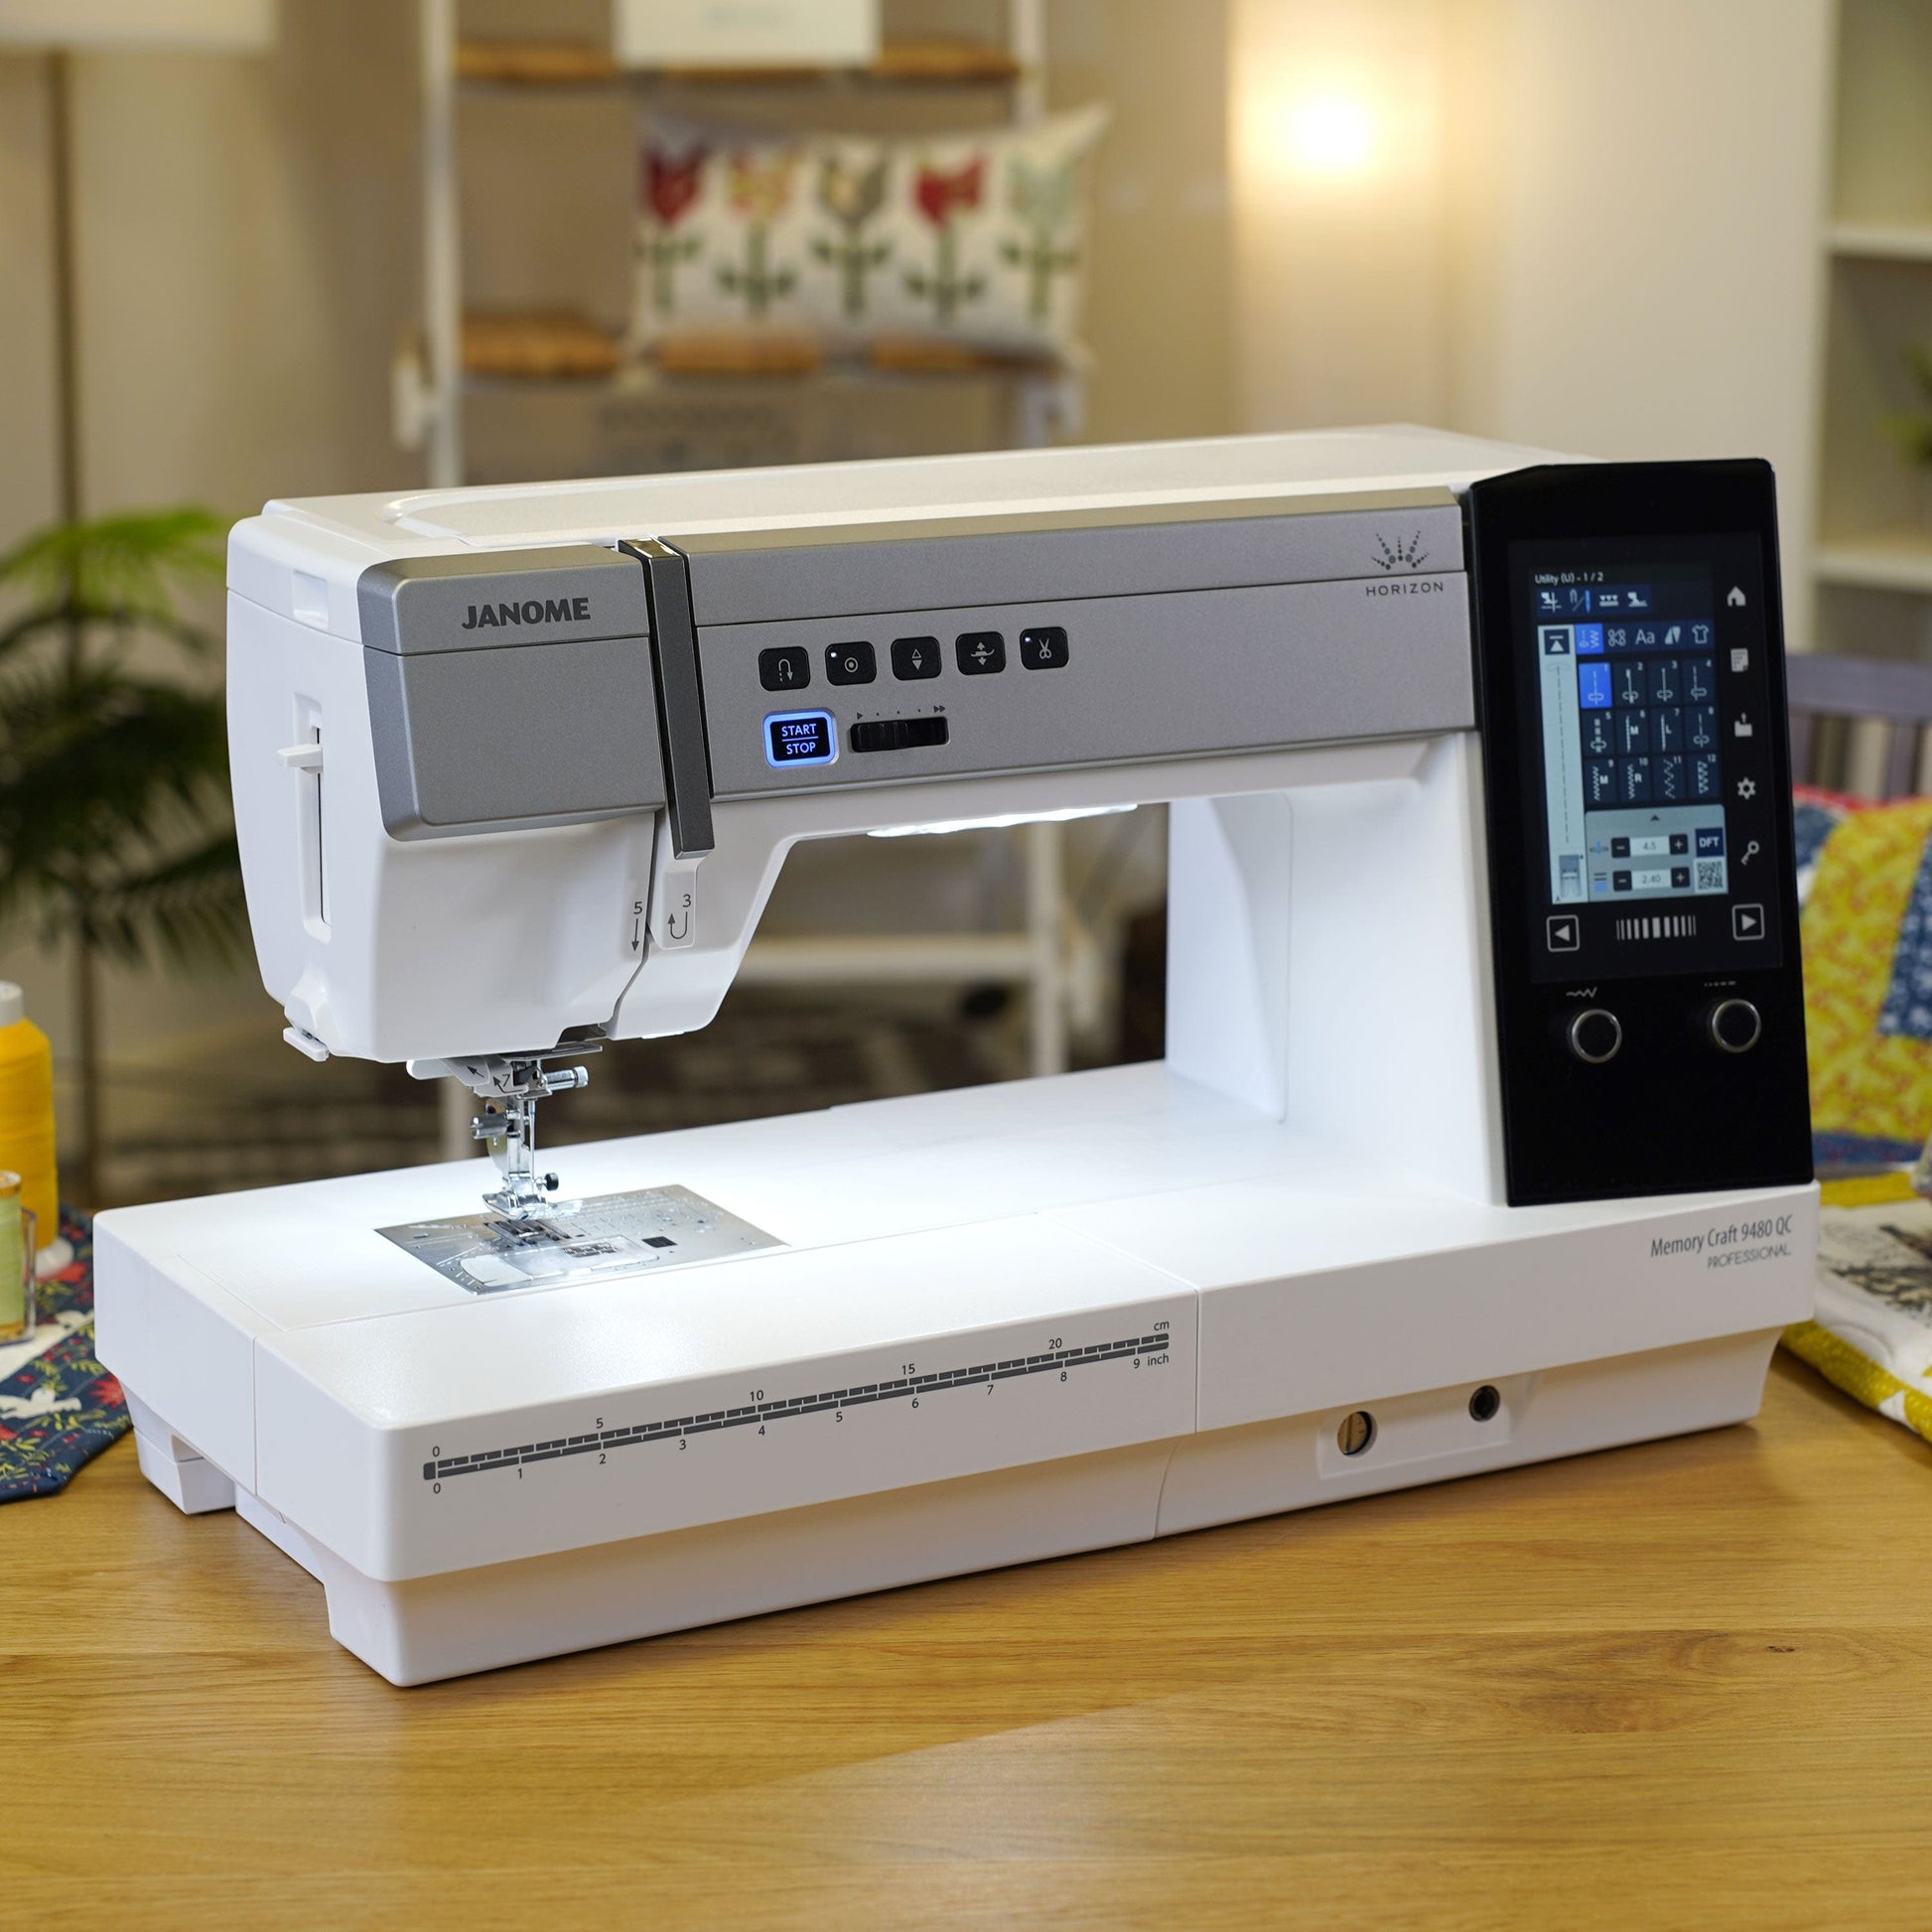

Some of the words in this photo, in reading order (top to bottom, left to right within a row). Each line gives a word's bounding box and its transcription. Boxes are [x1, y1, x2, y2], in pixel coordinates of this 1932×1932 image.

[1534, 573, 1559, 586] Utility
[1597, 571, 1604, 583] 2
[1365, 582, 1444, 597] HORIZON
[462, 597, 591, 630] JANOME
[1635, 628, 1656, 645] Aa
[1637, 661, 1644, 671] 2
[780, 723, 817, 738] START
[785, 740, 817, 756] STOP
[1708, 754, 1717, 762] 12
[1699, 836, 1720, 848] DFT
[1641, 874, 1661, 885] 2.40
[633, 901, 643, 915] 5
[682, 895, 692, 908] 3
[501, 1073, 511, 1088] 7
[1650, 1236, 1705, 1258] Memory
[1708, 1224, 1737, 1247] Craft
[1741, 1218, 1773, 1241] 9480
[1775, 1214, 1793, 1236] QC
[1707, 1243, 1792, 1269] PROFESSIONAL
[432, 1446, 441, 1458] 0
[596, 1417, 604, 1429] 5
[750, 1390, 764, 1402] 10
[901, 1363, 915, 1375] 15
[1048, 1337, 1062, 1350] 20
[1153, 1320, 1170, 1331] cm
[433, 1482, 441, 1494] 0
[516, 1468, 523, 1479] 1
[598, 1453, 607, 1465] 2
[679, 1439, 687, 1451] 3
[758, 1425, 766, 1437] 4
[835, 1411, 843, 1423] 5
[911, 1398, 919, 1409] 6
[986, 1384, 994, 1396] 7
[1059, 1371, 1067, 1383] 8
[1133, 1358, 1141, 1369] 9
[1147, 1352, 1170, 1367] inch
